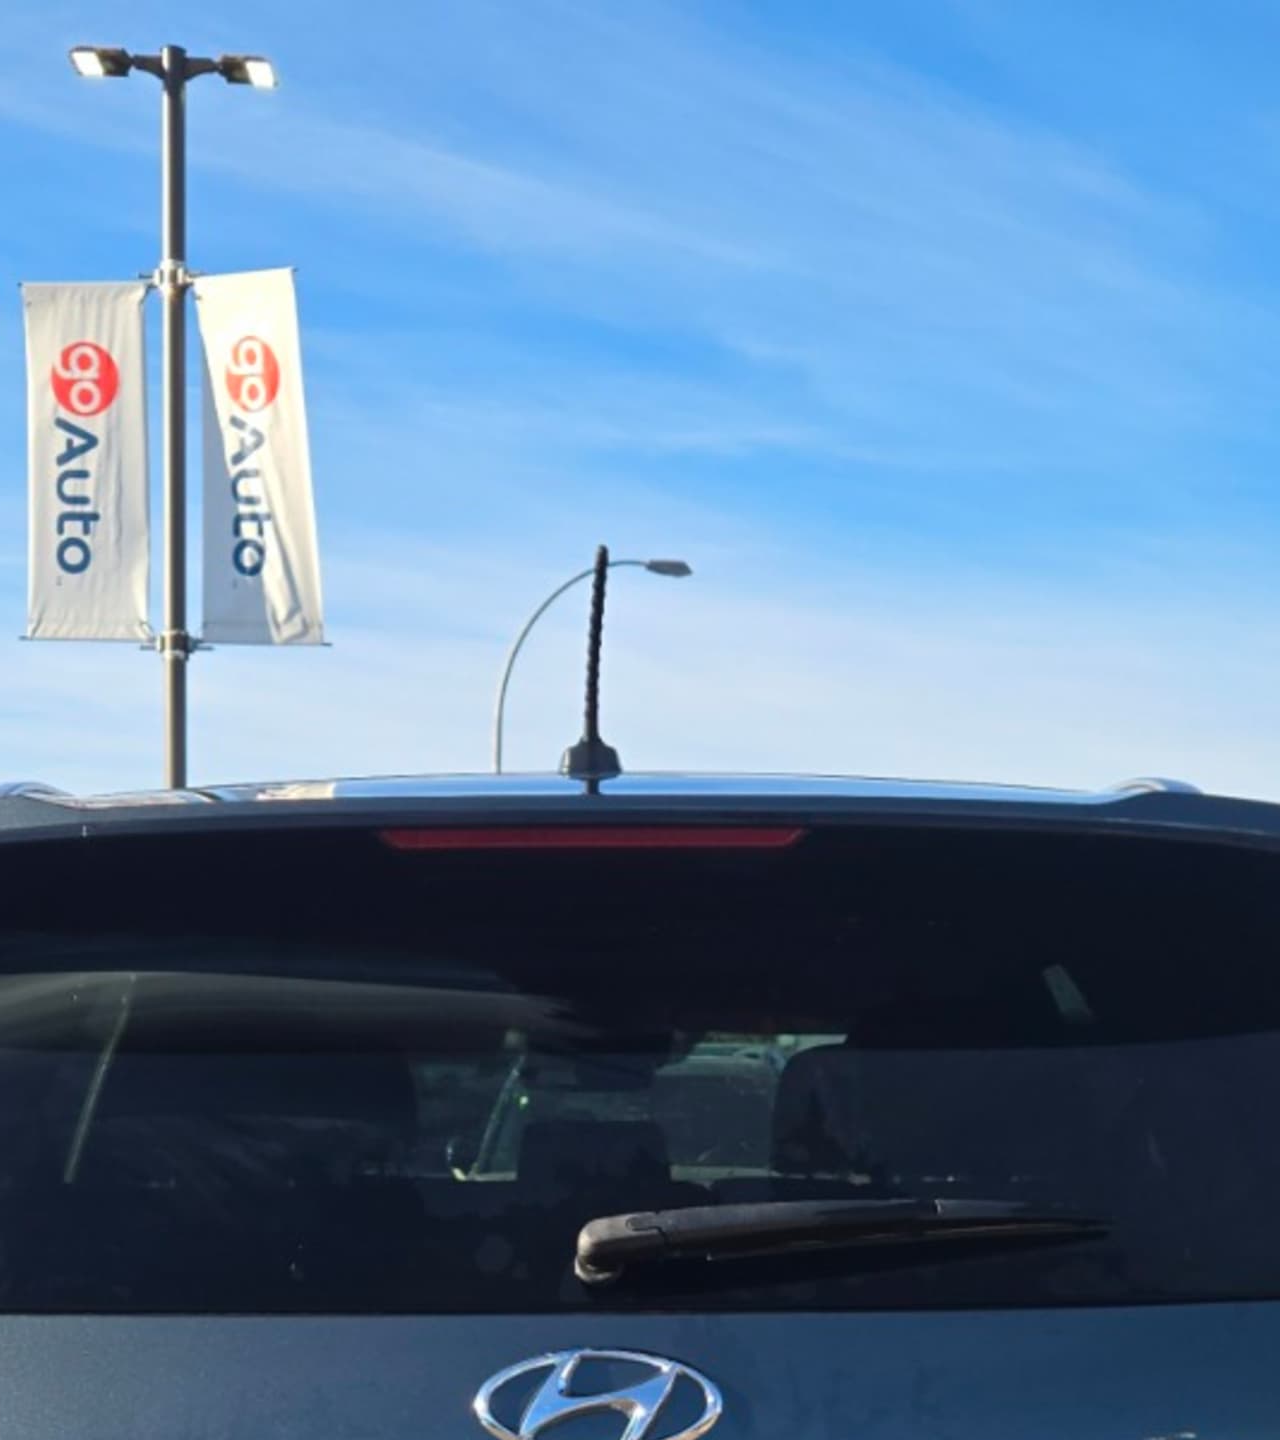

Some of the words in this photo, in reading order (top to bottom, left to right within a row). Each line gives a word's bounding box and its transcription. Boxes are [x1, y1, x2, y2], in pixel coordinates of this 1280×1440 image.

[52, 344, 102, 414] go
[229, 338, 269, 412] go
[54, 417, 101, 575] Auto
[229, 415, 271, 577] Auto
